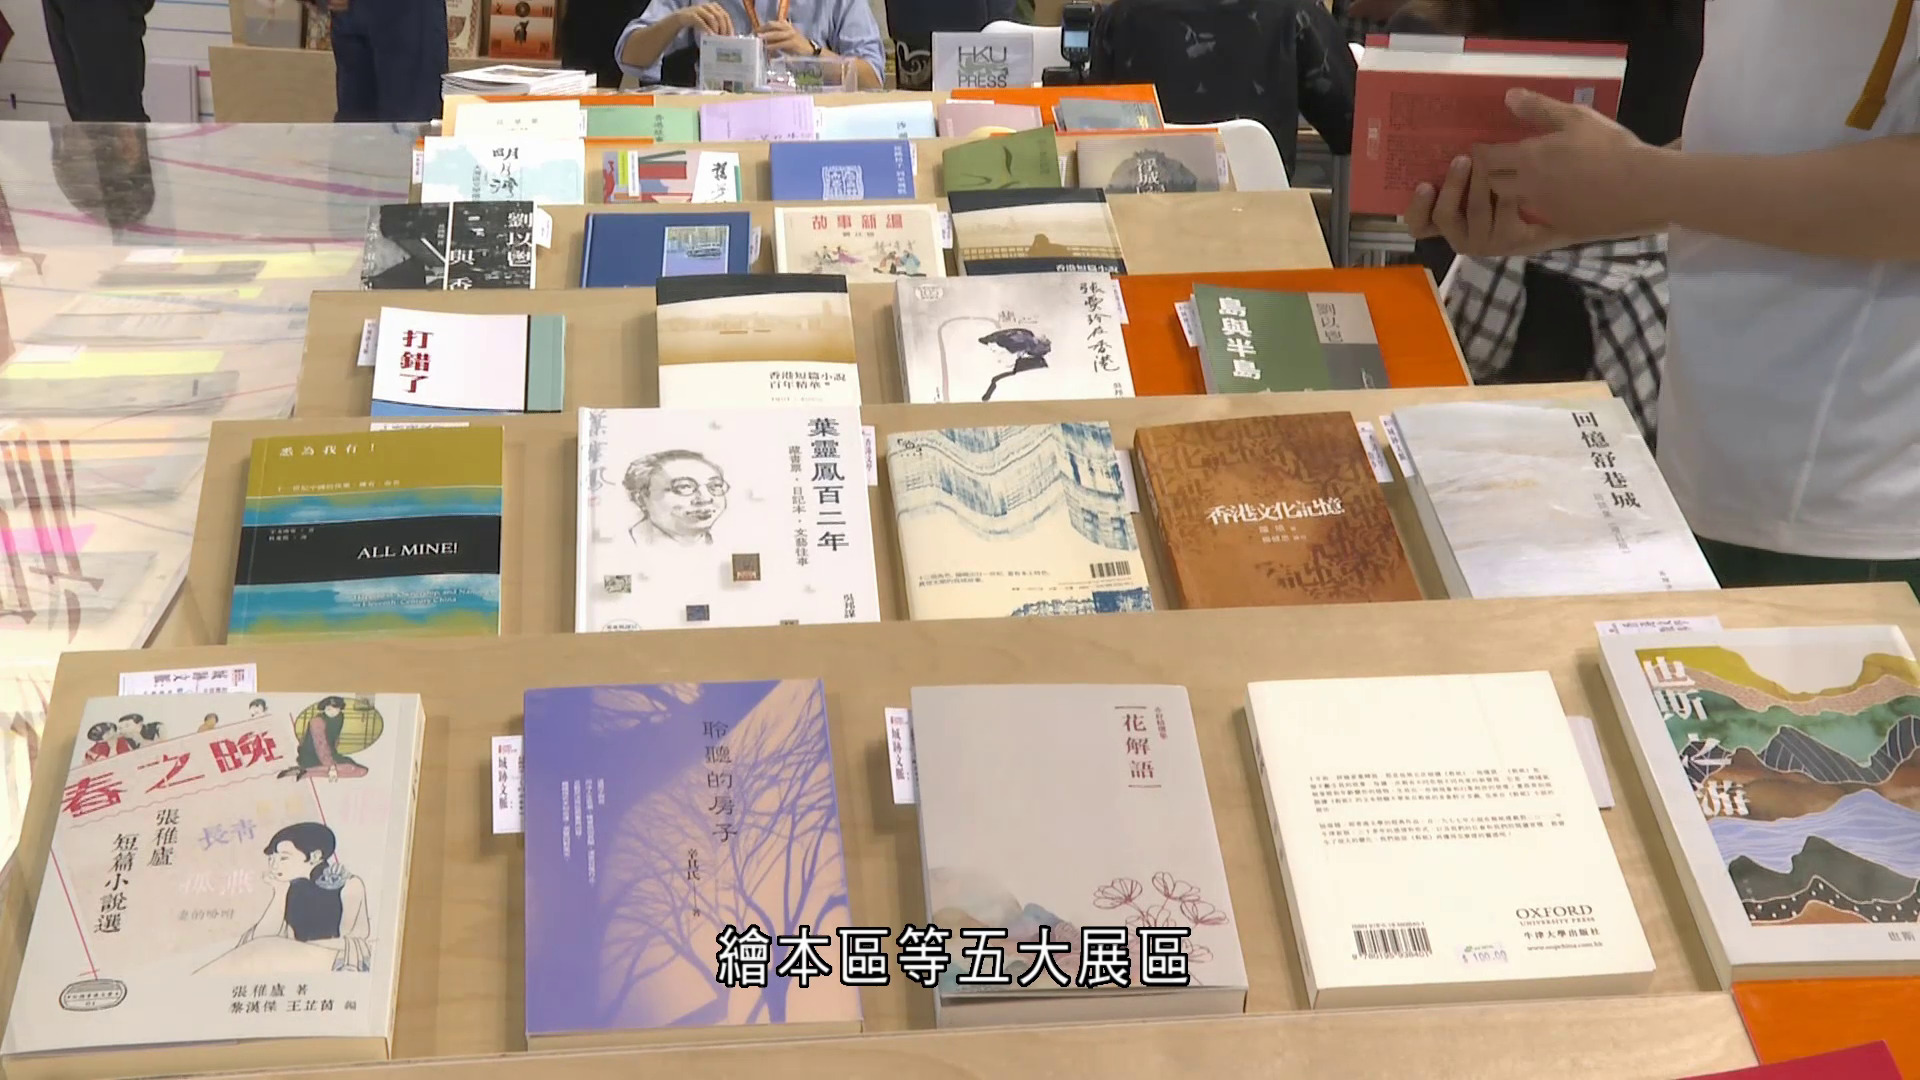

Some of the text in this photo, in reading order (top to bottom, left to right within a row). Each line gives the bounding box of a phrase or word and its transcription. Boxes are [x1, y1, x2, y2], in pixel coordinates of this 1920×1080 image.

[957, 46, 1008, 64] HKU
[957, 73, 1008, 88] PRESS
[1219, 297, 1261, 380] 島與半島
[400, 330, 434, 393] 打錯了
[770, 371, 846, 381] 香港短篇小說
[1572, 411, 1641, 508] 回憶舒巷城
[807, 418, 849, 551] 葉靈鳳百二年
[1205, 497, 1345, 525] 香港文化記憶
[357, 543, 458, 560] ALL MINE!
[1122, 713, 1154, 779] 花解語
[62, 730, 284, 818] 春之晚
[702, 720, 738, 842] 聆聽的房子
[94, 832, 140, 934] 短篇小說選
[1515, 904, 1594, 920] OXFORD
[1519, 916, 1596, 927] UNIVERSITY PRESS
[1524, 927, 1601, 940] 牛津大學出版社
